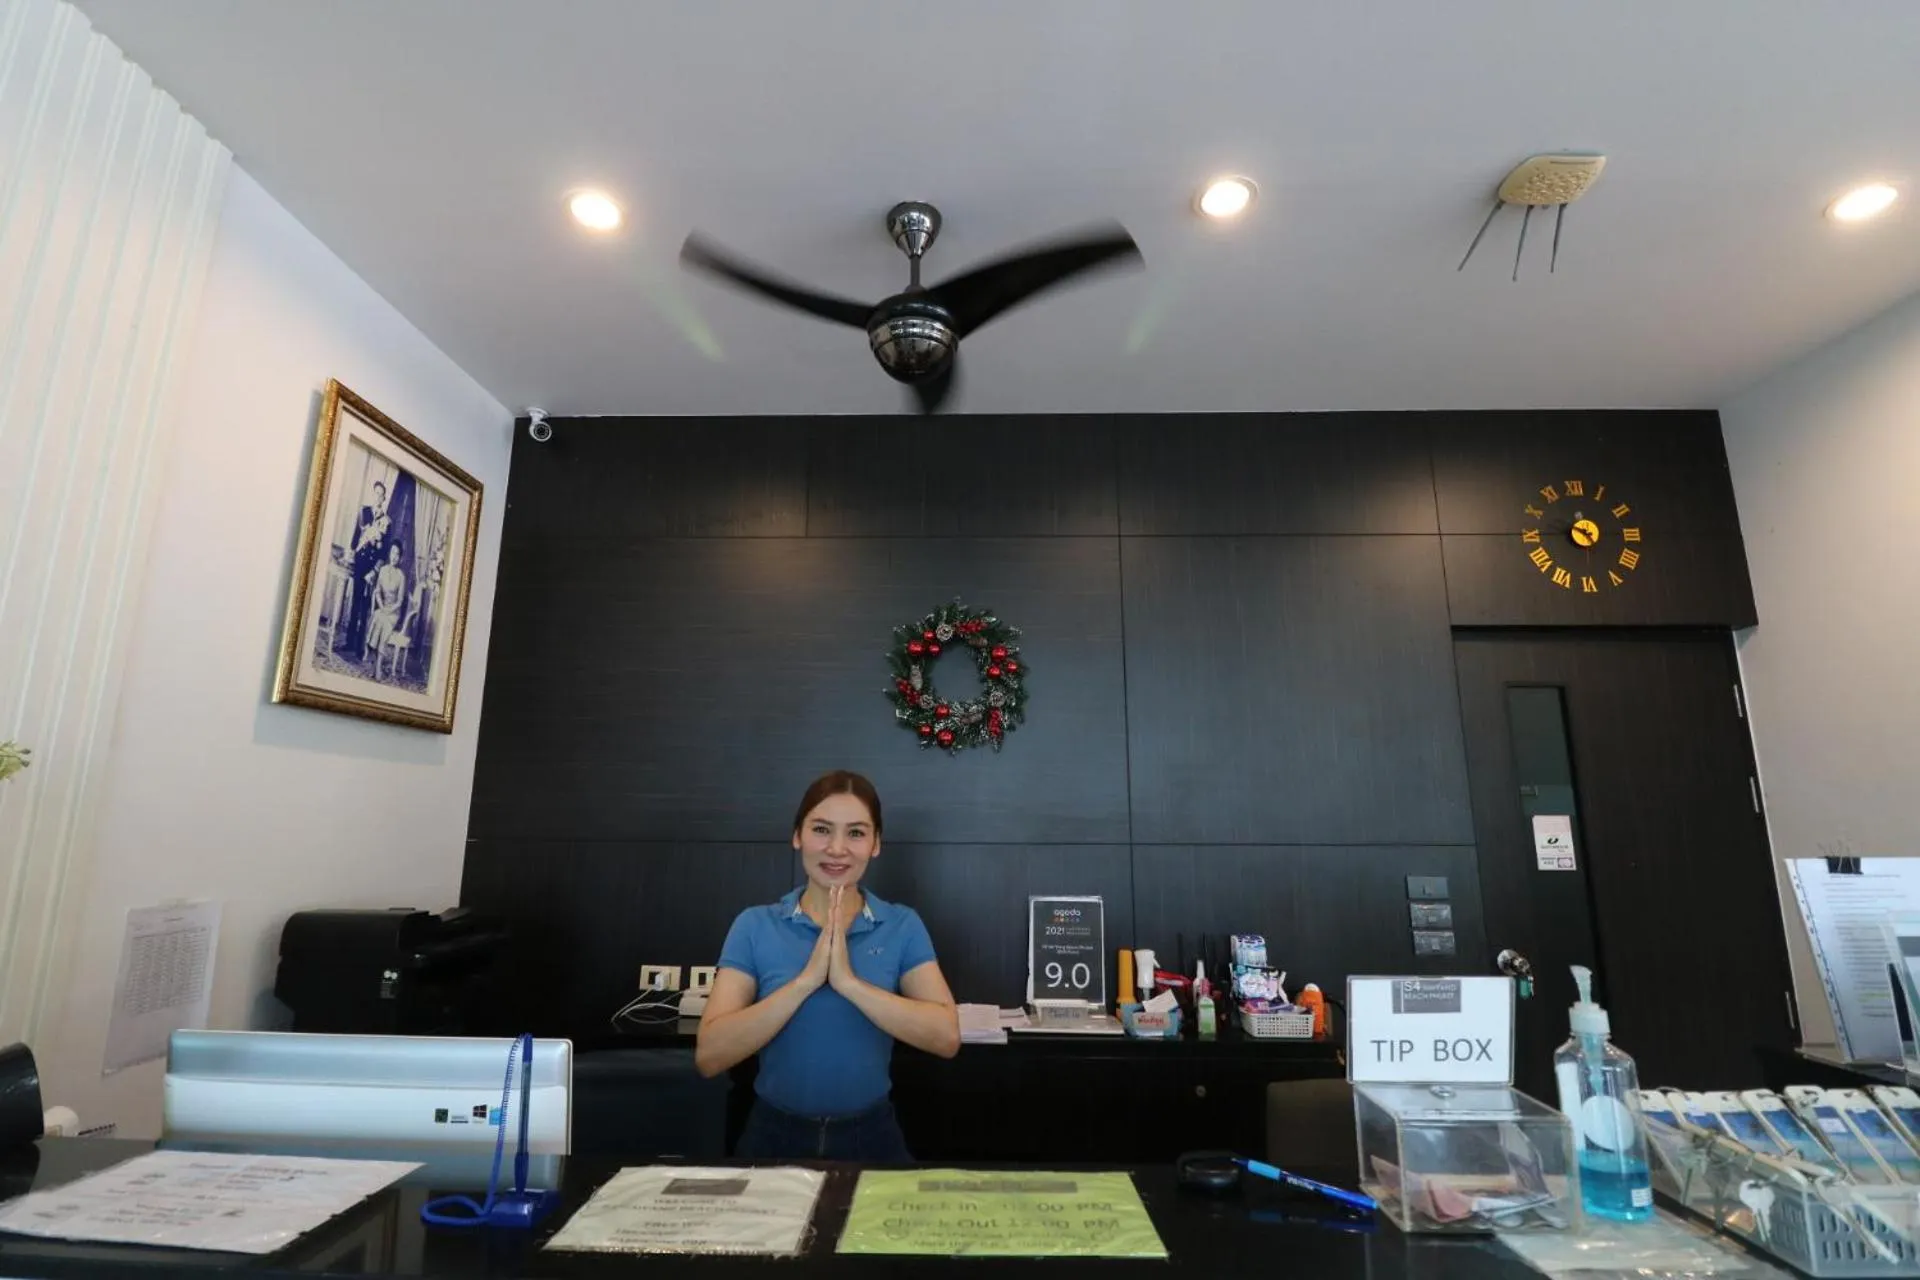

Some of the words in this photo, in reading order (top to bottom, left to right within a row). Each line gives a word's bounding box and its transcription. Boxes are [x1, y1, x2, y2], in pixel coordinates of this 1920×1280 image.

[1564, 480, 1584, 496] XII
[1524, 503, 1544, 520] X
[1611, 503, 1631, 519] II
[1622, 527, 1641, 542] III
[1528, 546, 1554, 573] VIII
[1552, 567, 1572, 589] VII
[1581, 576, 1598, 593] VI
[1608, 569, 1623, 586] V
[1053, 909, 1081, 918] agoda
[1045, 926, 1065, 936] 2021
[1045, 962, 1090, 989] 9.0
[1404, 980, 1421, 992] S4
[1370, 1039, 1414, 1062] TIP
[1433, 1038, 1493, 1062] BOX
[1076, 1201, 1113, 1212] PM
[957, 1218, 999, 1229] Out
[1083, 1218, 1120, 1229] PM
